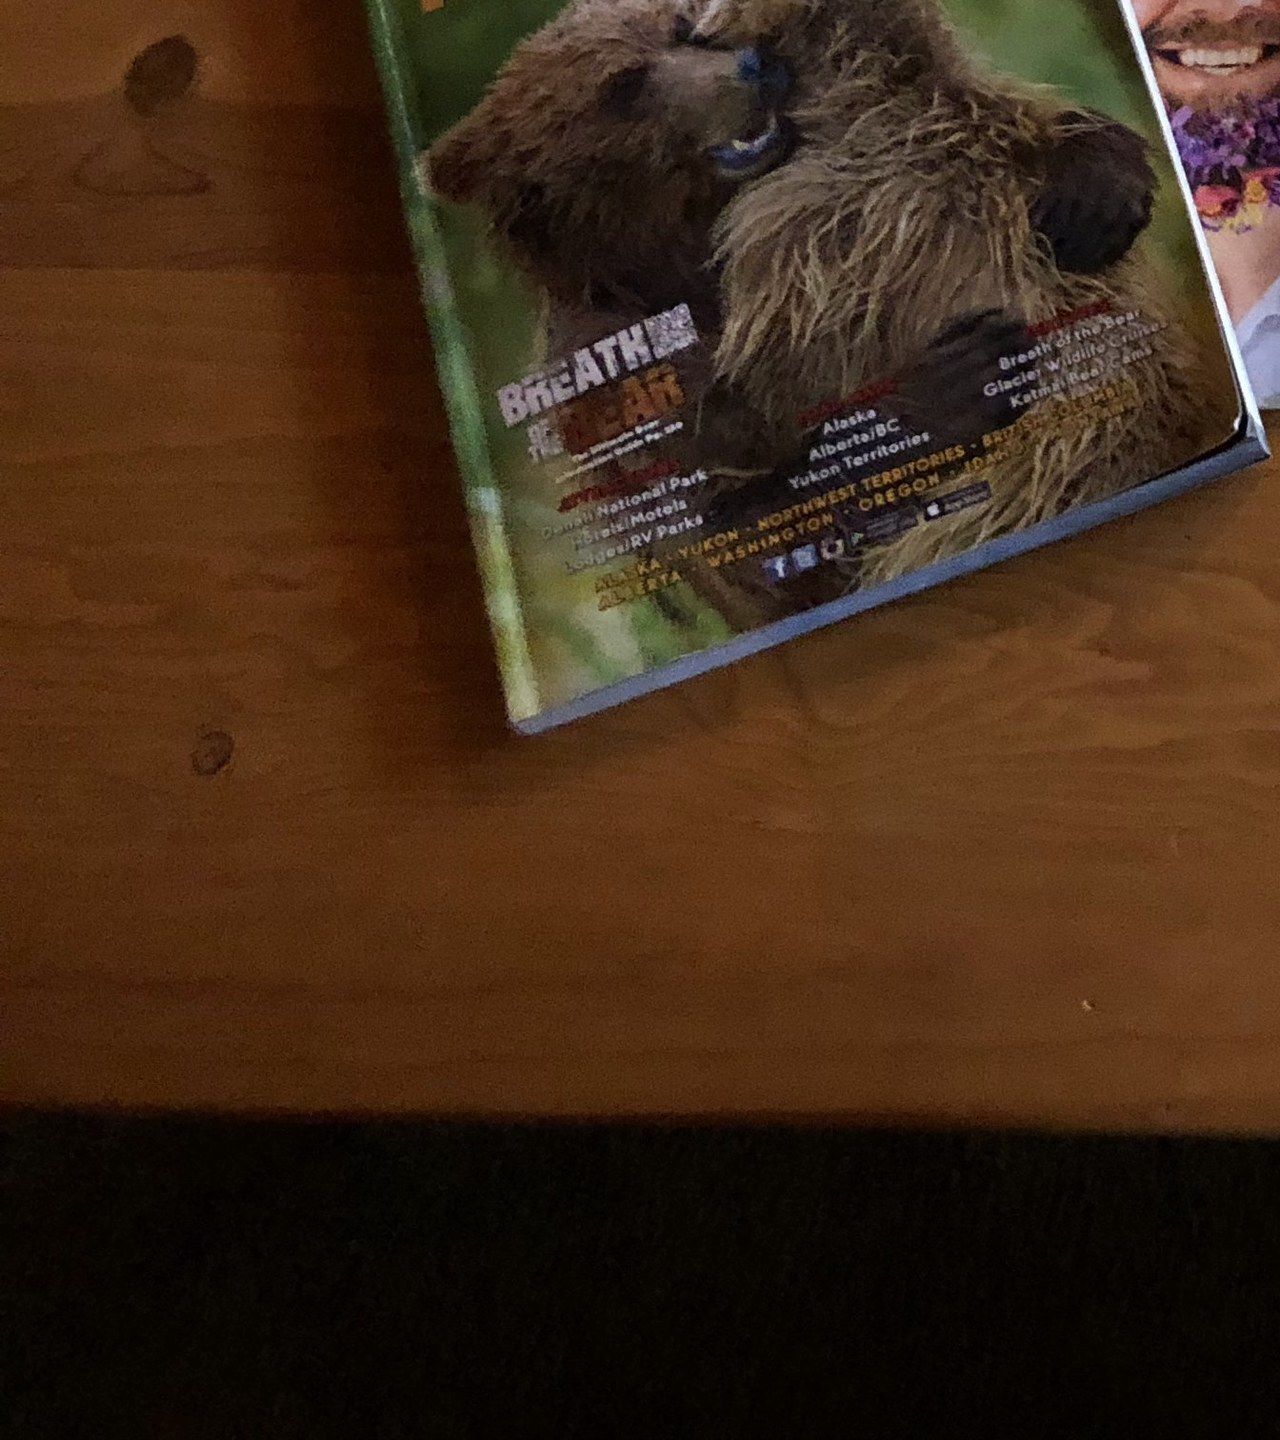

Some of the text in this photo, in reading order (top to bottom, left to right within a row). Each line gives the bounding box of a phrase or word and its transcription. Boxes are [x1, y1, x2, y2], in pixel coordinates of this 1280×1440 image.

[998, 342, 1052, 370] Breath
[1074, 322, 1101, 340] the
[1102, 309, 1140, 329] Bear
[498, 322, 654, 428] BREATH
[982, 368, 1041, 397] Glacier
[1044, 343, 1106, 372] Wildlife
[809, 417, 901, 462] Alberta/BC
[823, 409, 877, 436] Alaska
[788, 432, 930, 489] Yukon Territories
[596, 482, 667, 516] National
[668, 467, 710, 492] Park
[677, 528, 740, 565] YUKON
[756, 481, 857, 531] NORTHWEST
[860, 443, 967, 493] TERRITORIES
[656, 513, 704, 539] Parks
[707, 521, 834, 569] WASHINGTON
[857, 471, 941, 513] OREGON
